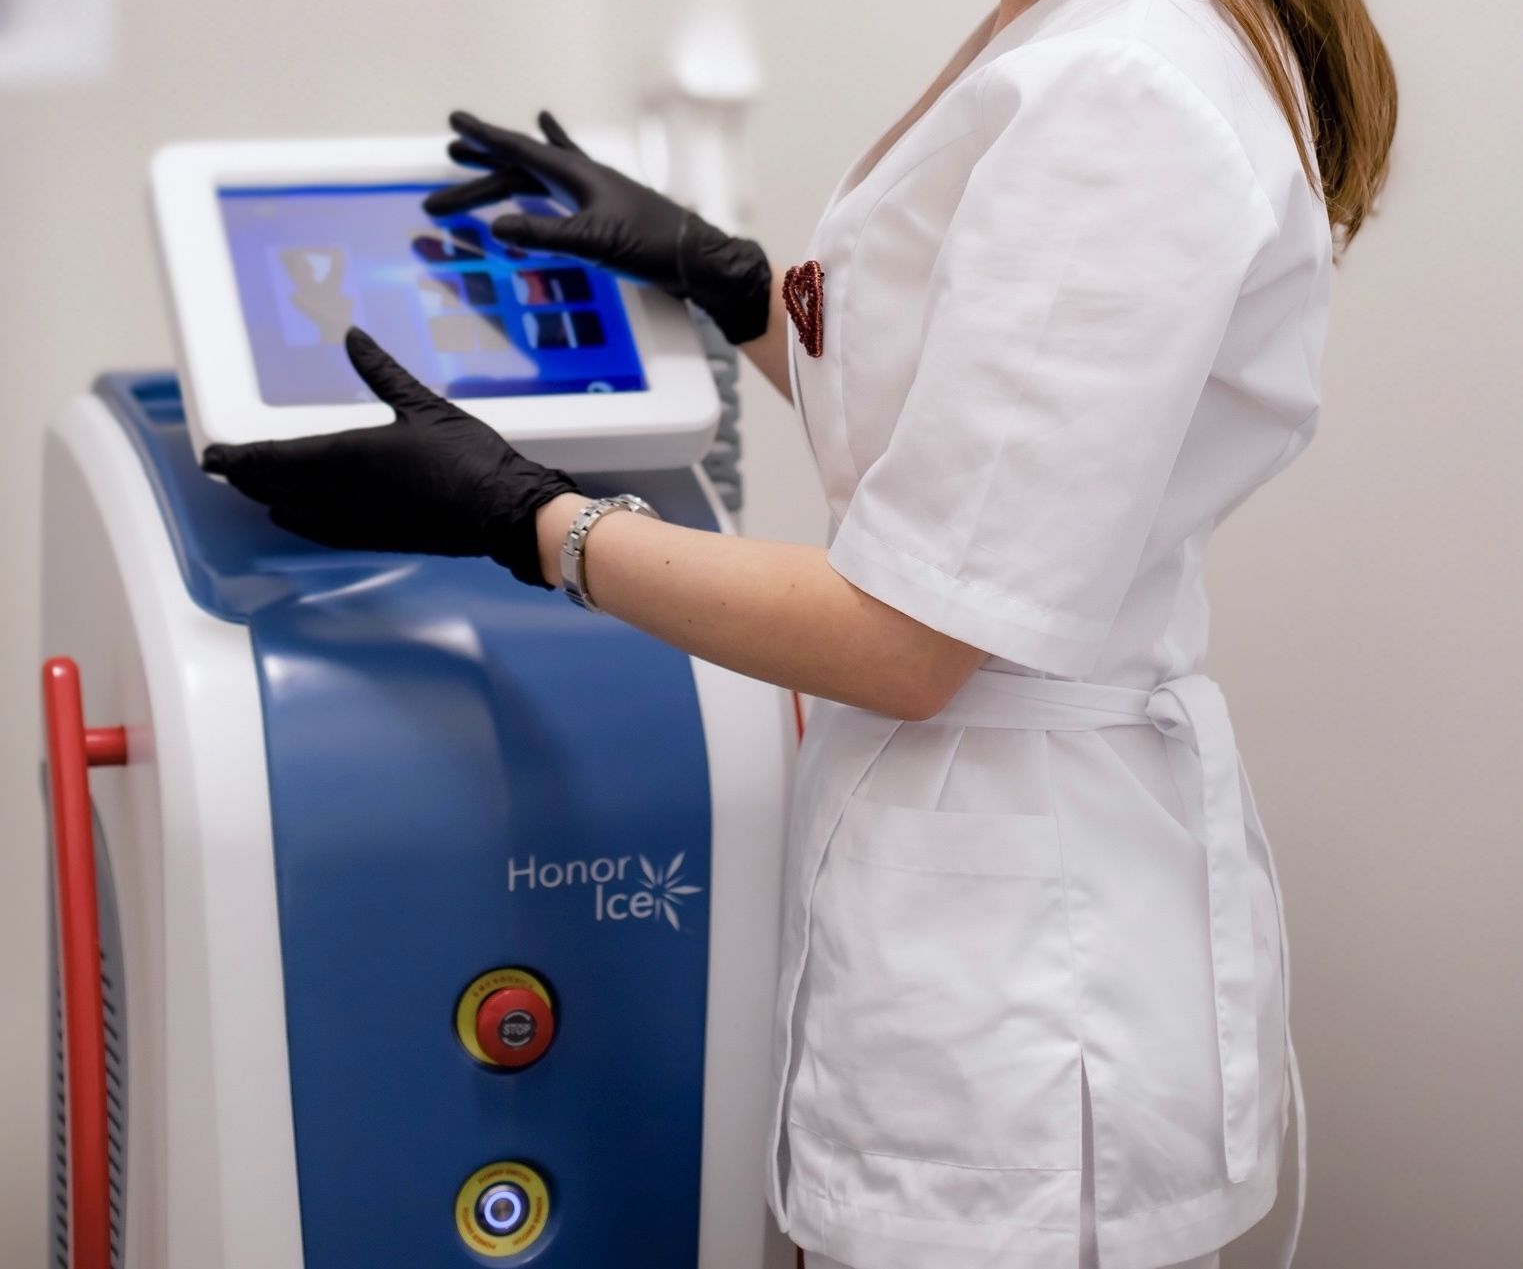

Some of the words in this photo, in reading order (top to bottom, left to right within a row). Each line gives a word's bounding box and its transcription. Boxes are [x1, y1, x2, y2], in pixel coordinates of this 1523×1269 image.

[508, 855, 632, 892] Honor
[595, 884, 654, 921] Ice
[503, 1023, 531, 1035] STOP
